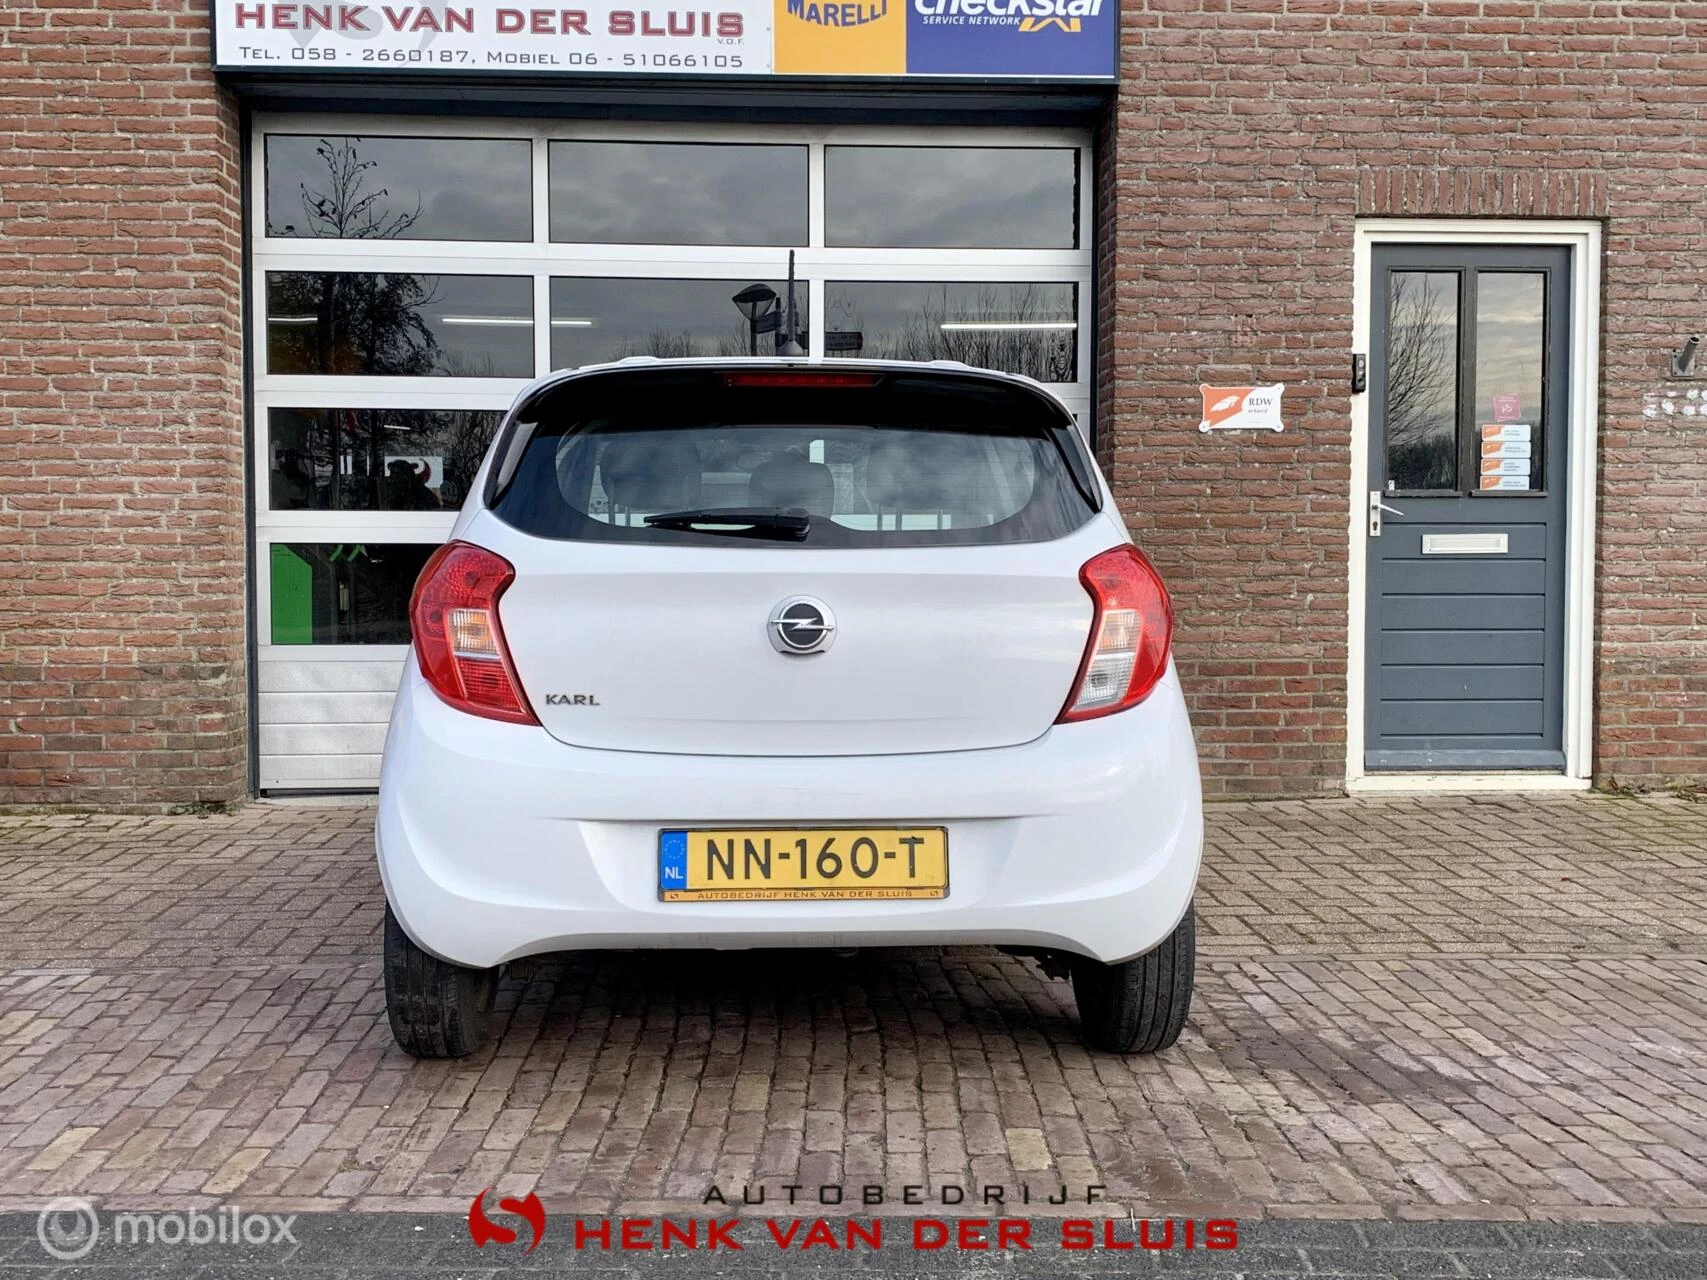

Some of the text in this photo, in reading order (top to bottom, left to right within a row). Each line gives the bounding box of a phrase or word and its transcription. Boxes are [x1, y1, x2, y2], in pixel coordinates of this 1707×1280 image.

[235, 3, 744, 38] HENK VAN DER SLUIS
[787, 0, 888, 27] MARELLI
[923, 16, 1021, 26] SERVICE NETWORK
[291, 47, 336, 61] 058
[362, 49, 476, 65] 2660187,
[569, 52, 598, 65] 06
[623, 54, 743, 68] 51066105
[1248, 397, 1273, 406] RDW
[545, 694, 601, 706] KARL
[665, 836, 925, 880] NL NN-160-T
[697, 891, 780, 900] AUTOBEDRIJF
[784, 891, 817, 899] HENK
[877, 890, 913, 898] SLUIS
